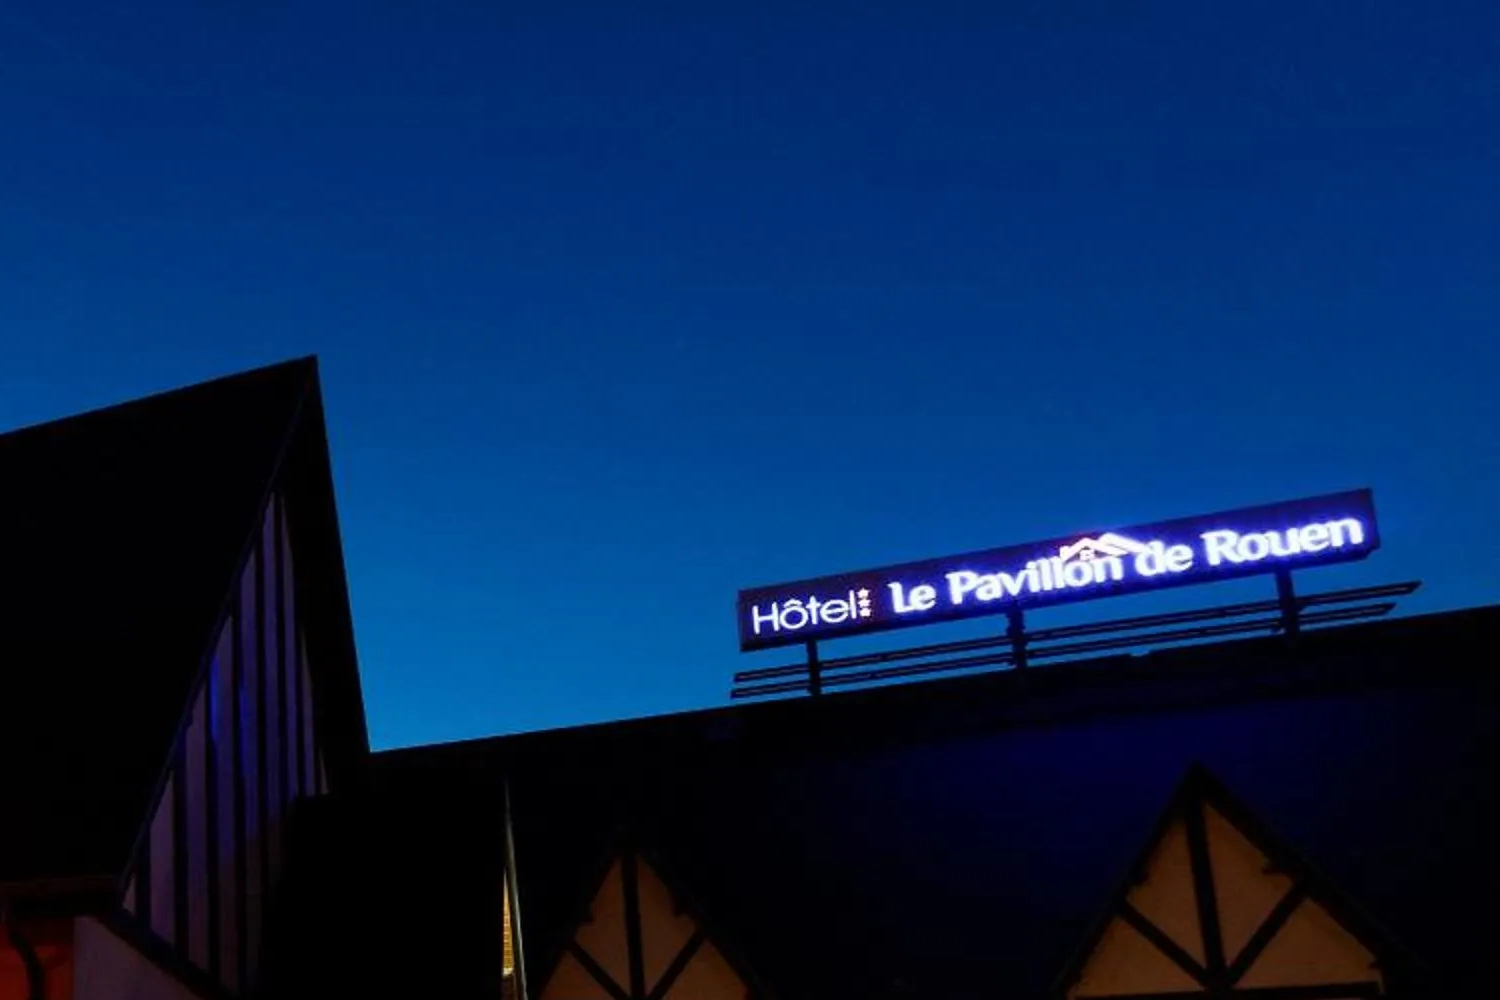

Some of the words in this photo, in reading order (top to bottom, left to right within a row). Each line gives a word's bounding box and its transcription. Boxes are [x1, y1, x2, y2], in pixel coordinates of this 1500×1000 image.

[752, 588, 858, 635] Hôtel
[887, 580, 937, 614] Le
[945, 552, 1124, 606] Pavillon
[1134, 539, 1194, 577] de
[1200, 516, 1364, 567] Rouen
